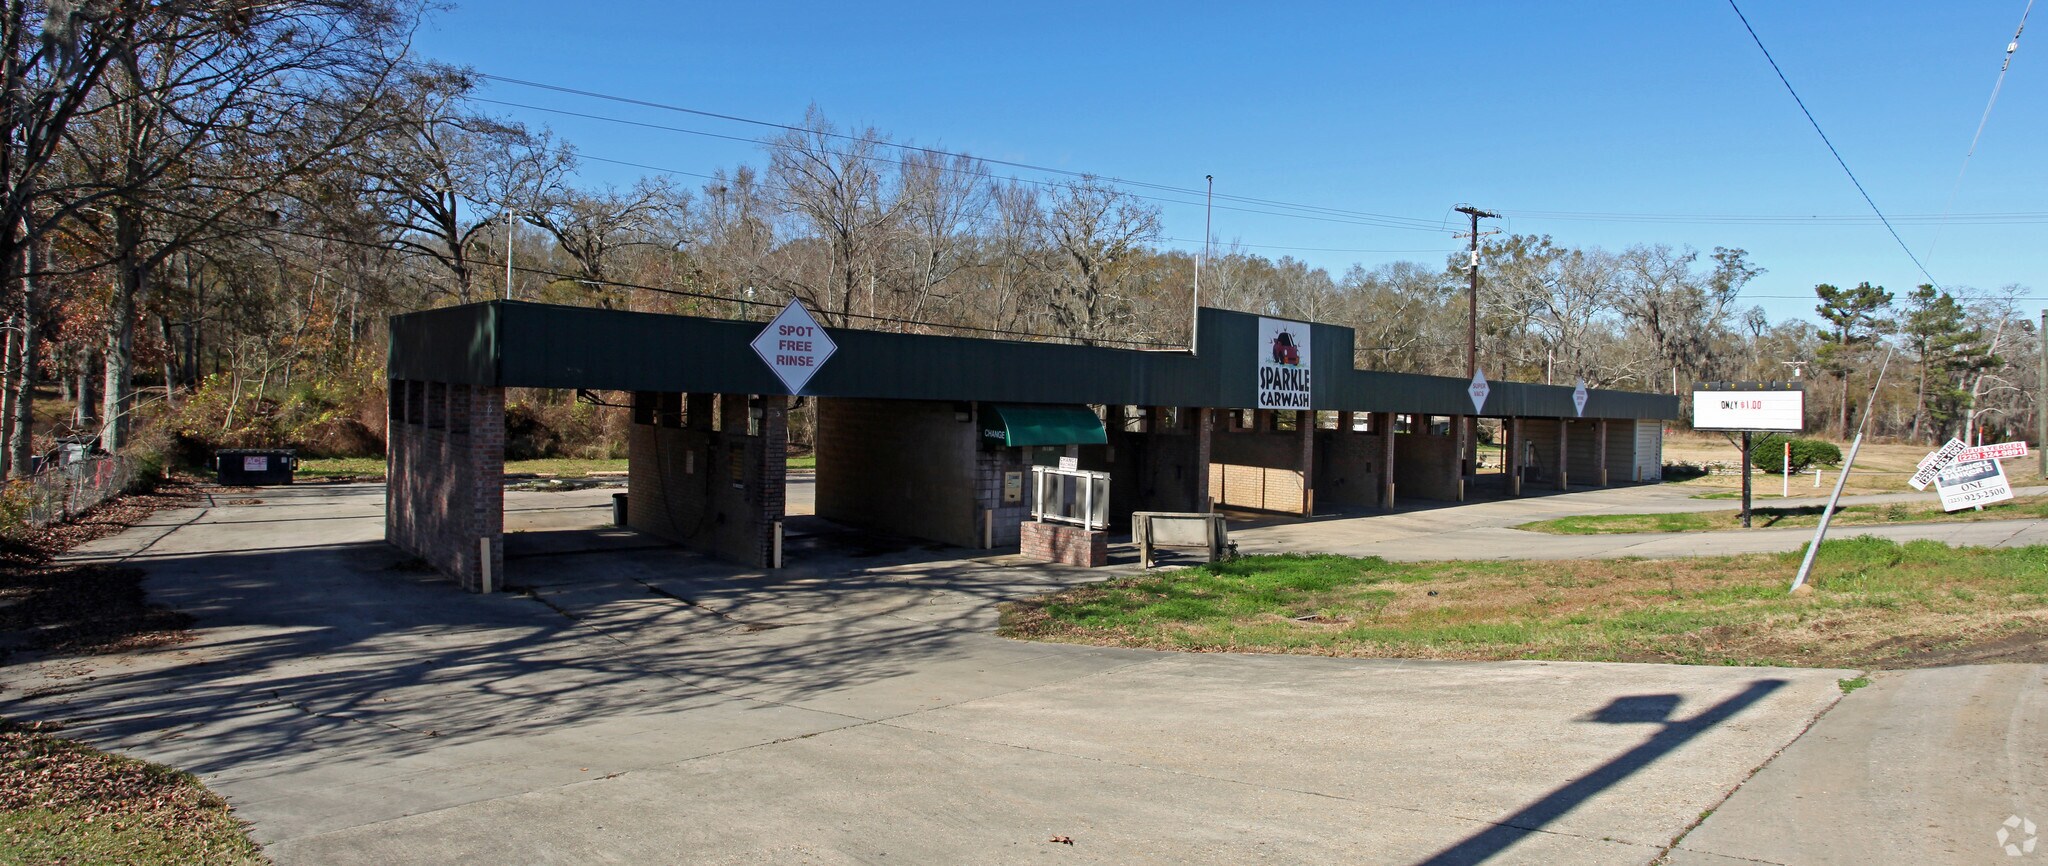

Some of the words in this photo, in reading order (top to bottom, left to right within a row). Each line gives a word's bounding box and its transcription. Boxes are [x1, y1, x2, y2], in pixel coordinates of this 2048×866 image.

[779, 325, 813, 337] SPOT
[779, 340, 812, 352] FREE
[776, 355, 814, 367] RINSE
[1260, 366, 1309, 392] SPARKLE
[1260, 391, 1309, 407] CARWASH
[1721, 400, 1738, 410] ONLY
[1740, 400, 1762, 410] $1.00
[984, 429, 1005, 439] CHANGE
[1987, 442, 2022, 451] YERGER
[1915, 462, 1934, 480] SANDY
[1933, 440, 1957, 463] LANTRIP
[1958, 453, 1980, 462] (225)
[1961, 481, 1983, 491] ONE
[1964, 487, 2005, 501] 925-2500
